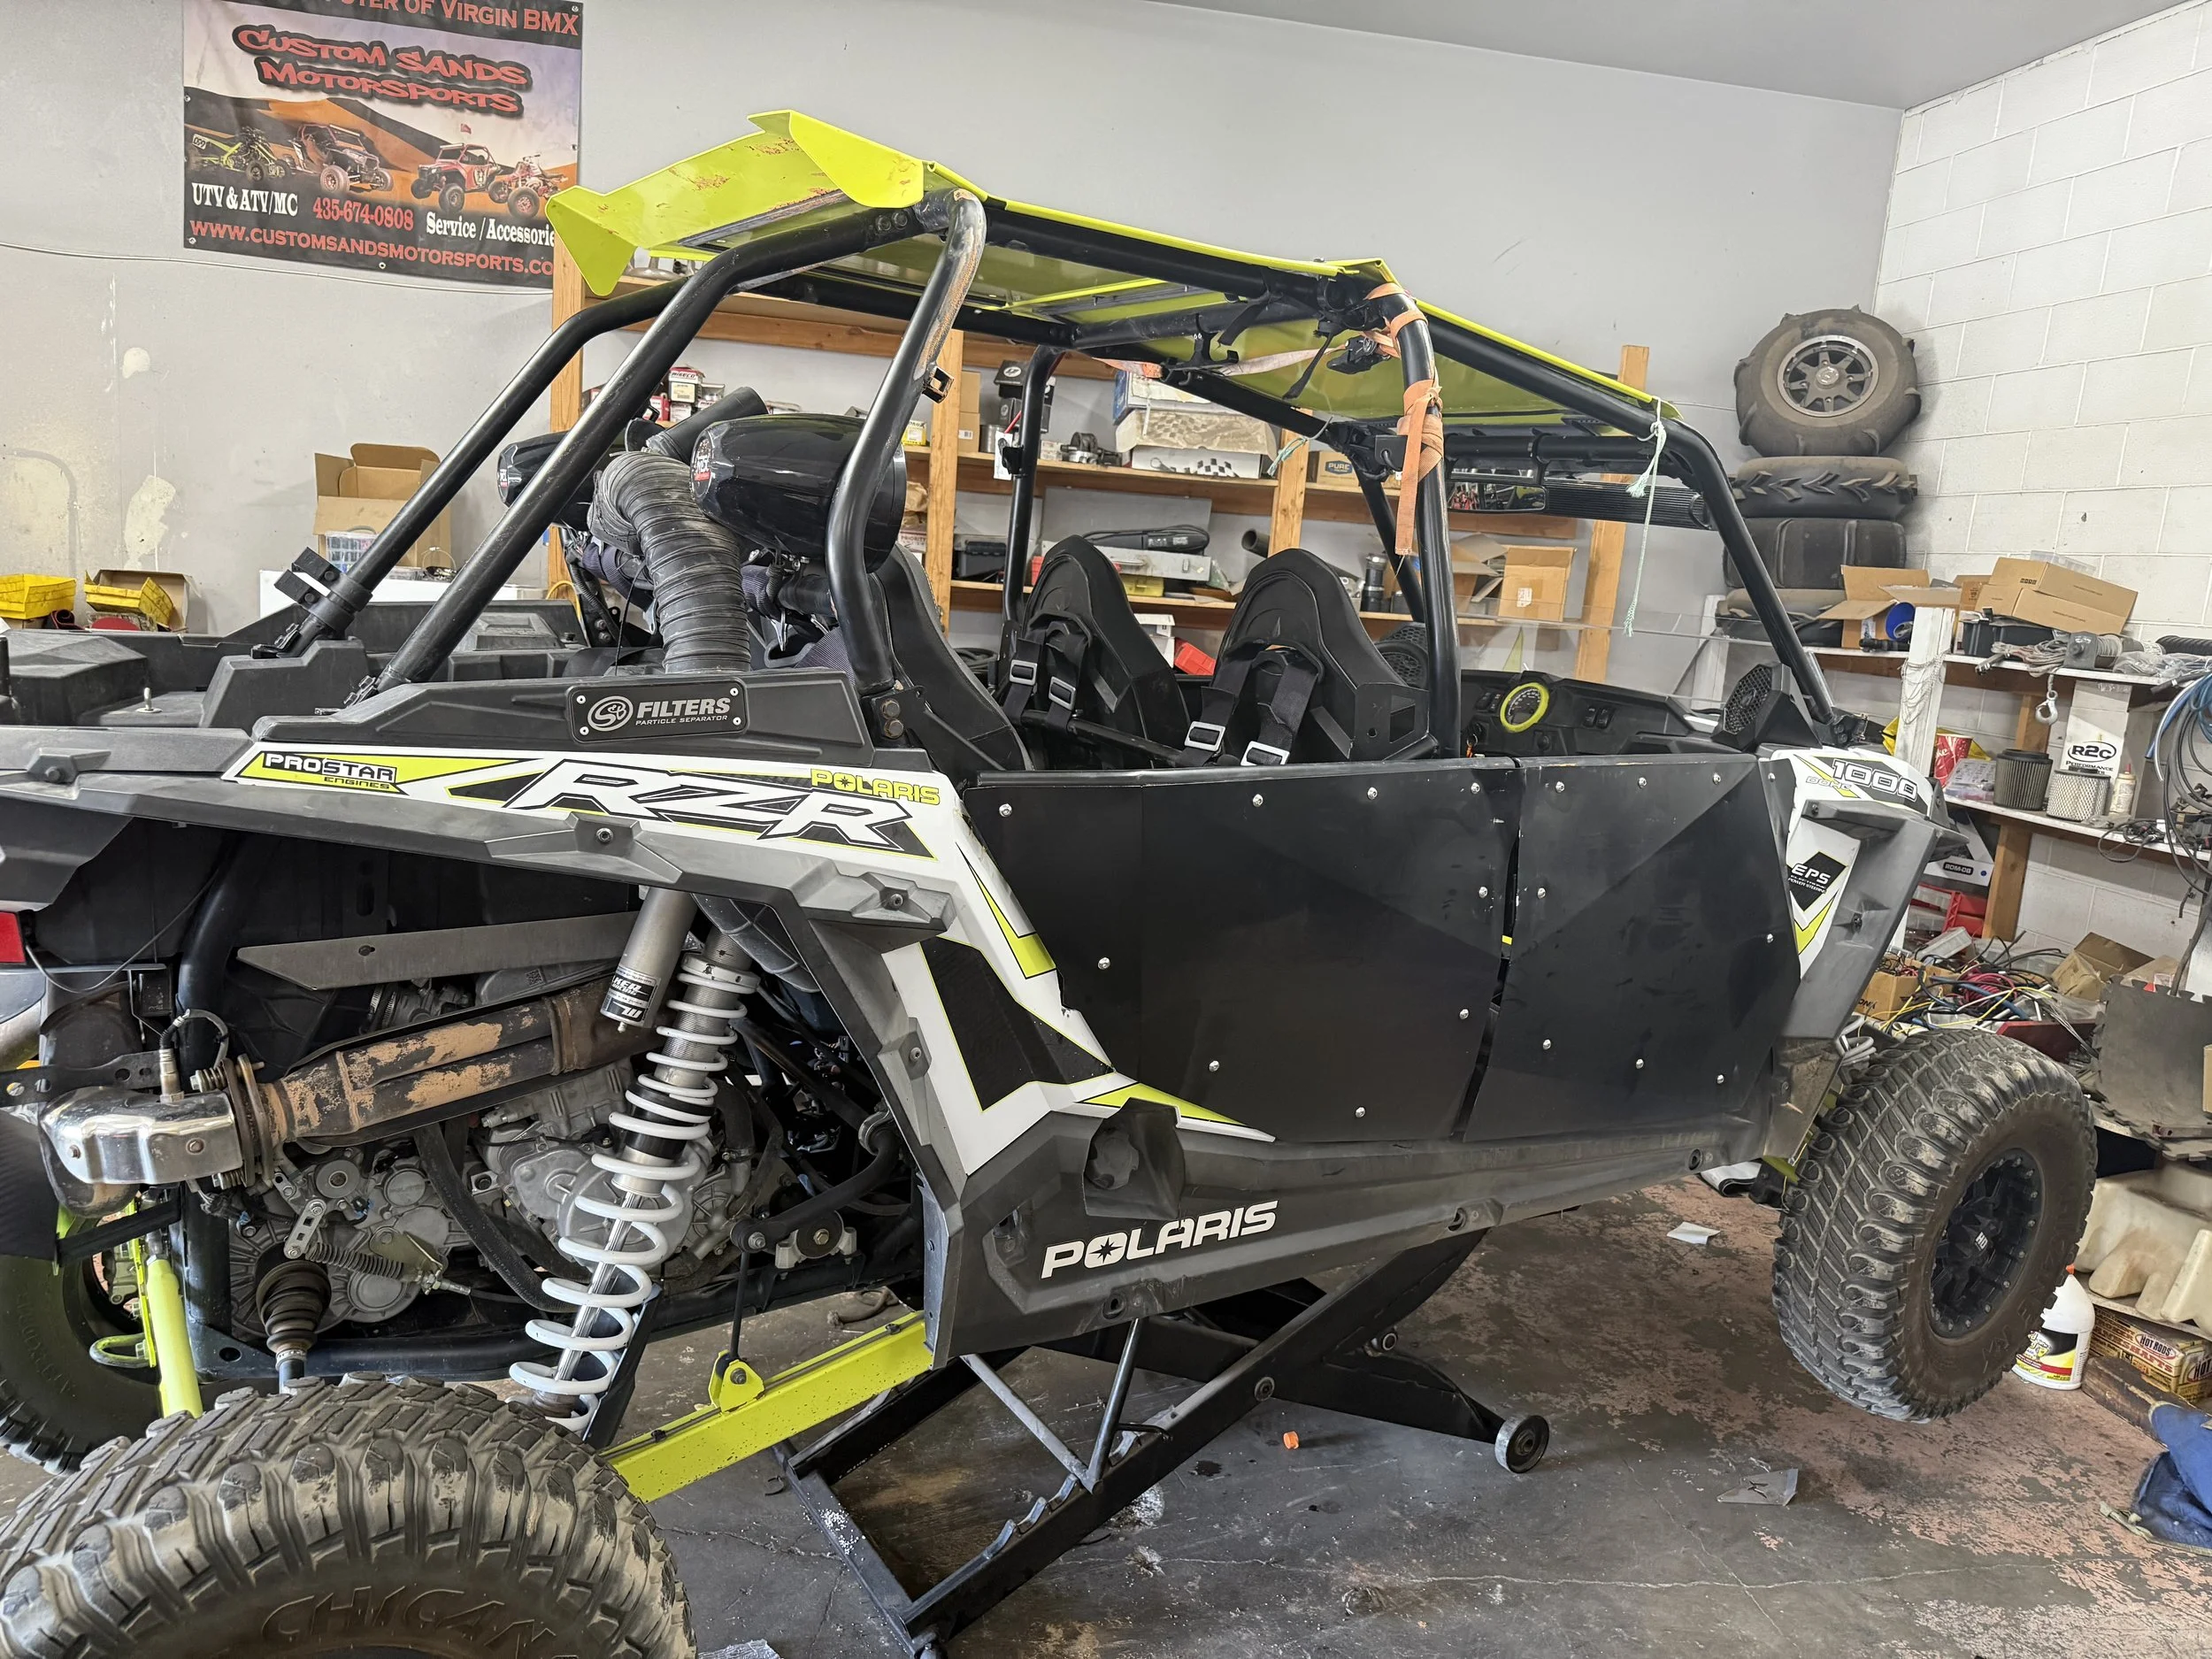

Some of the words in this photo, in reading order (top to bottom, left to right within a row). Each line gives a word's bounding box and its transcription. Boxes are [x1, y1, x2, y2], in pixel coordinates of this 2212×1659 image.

[404, 0, 433, 15] OF
[442, 0, 518, 28] VIRGIN
[523, 8, 580, 36] BMX
[237, 29, 387, 66] CUSTOM
[396, 50, 528, 86] SANDS
[259, 61, 519, 113] MOTORSPORTS
[191, 182, 226, 208] UTV
[312, 197, 414, 231] 435-674-0808
[426, 211, 477, 240] Service
[479, 217, 554, 248] /Accessorie
[189, 219, 554, 276] WWW.CUSTOMSANDSMOTORSPORTS.CO
[636, 697, 731, 718] FILTERS
[680, 715, 728, 724] SEPARATOR
[265, 753, 394, 781] PROSTAR
[2071, 745, 2112, 759] R2C
[324, 776, 390, 790] ENGINES
[810, 768, 941, 806] POLARIS
[1832, 758, 1918, 802] 1000
[502, 759, 915, 852] RZR
[1791, 864, 1831, 885] EPS
[1041, 1200, 1279, 1279] POLARIS
[2139, 1334, 2155, 1348] HOT
[2153, 1340, 2172, 1357] RODS
